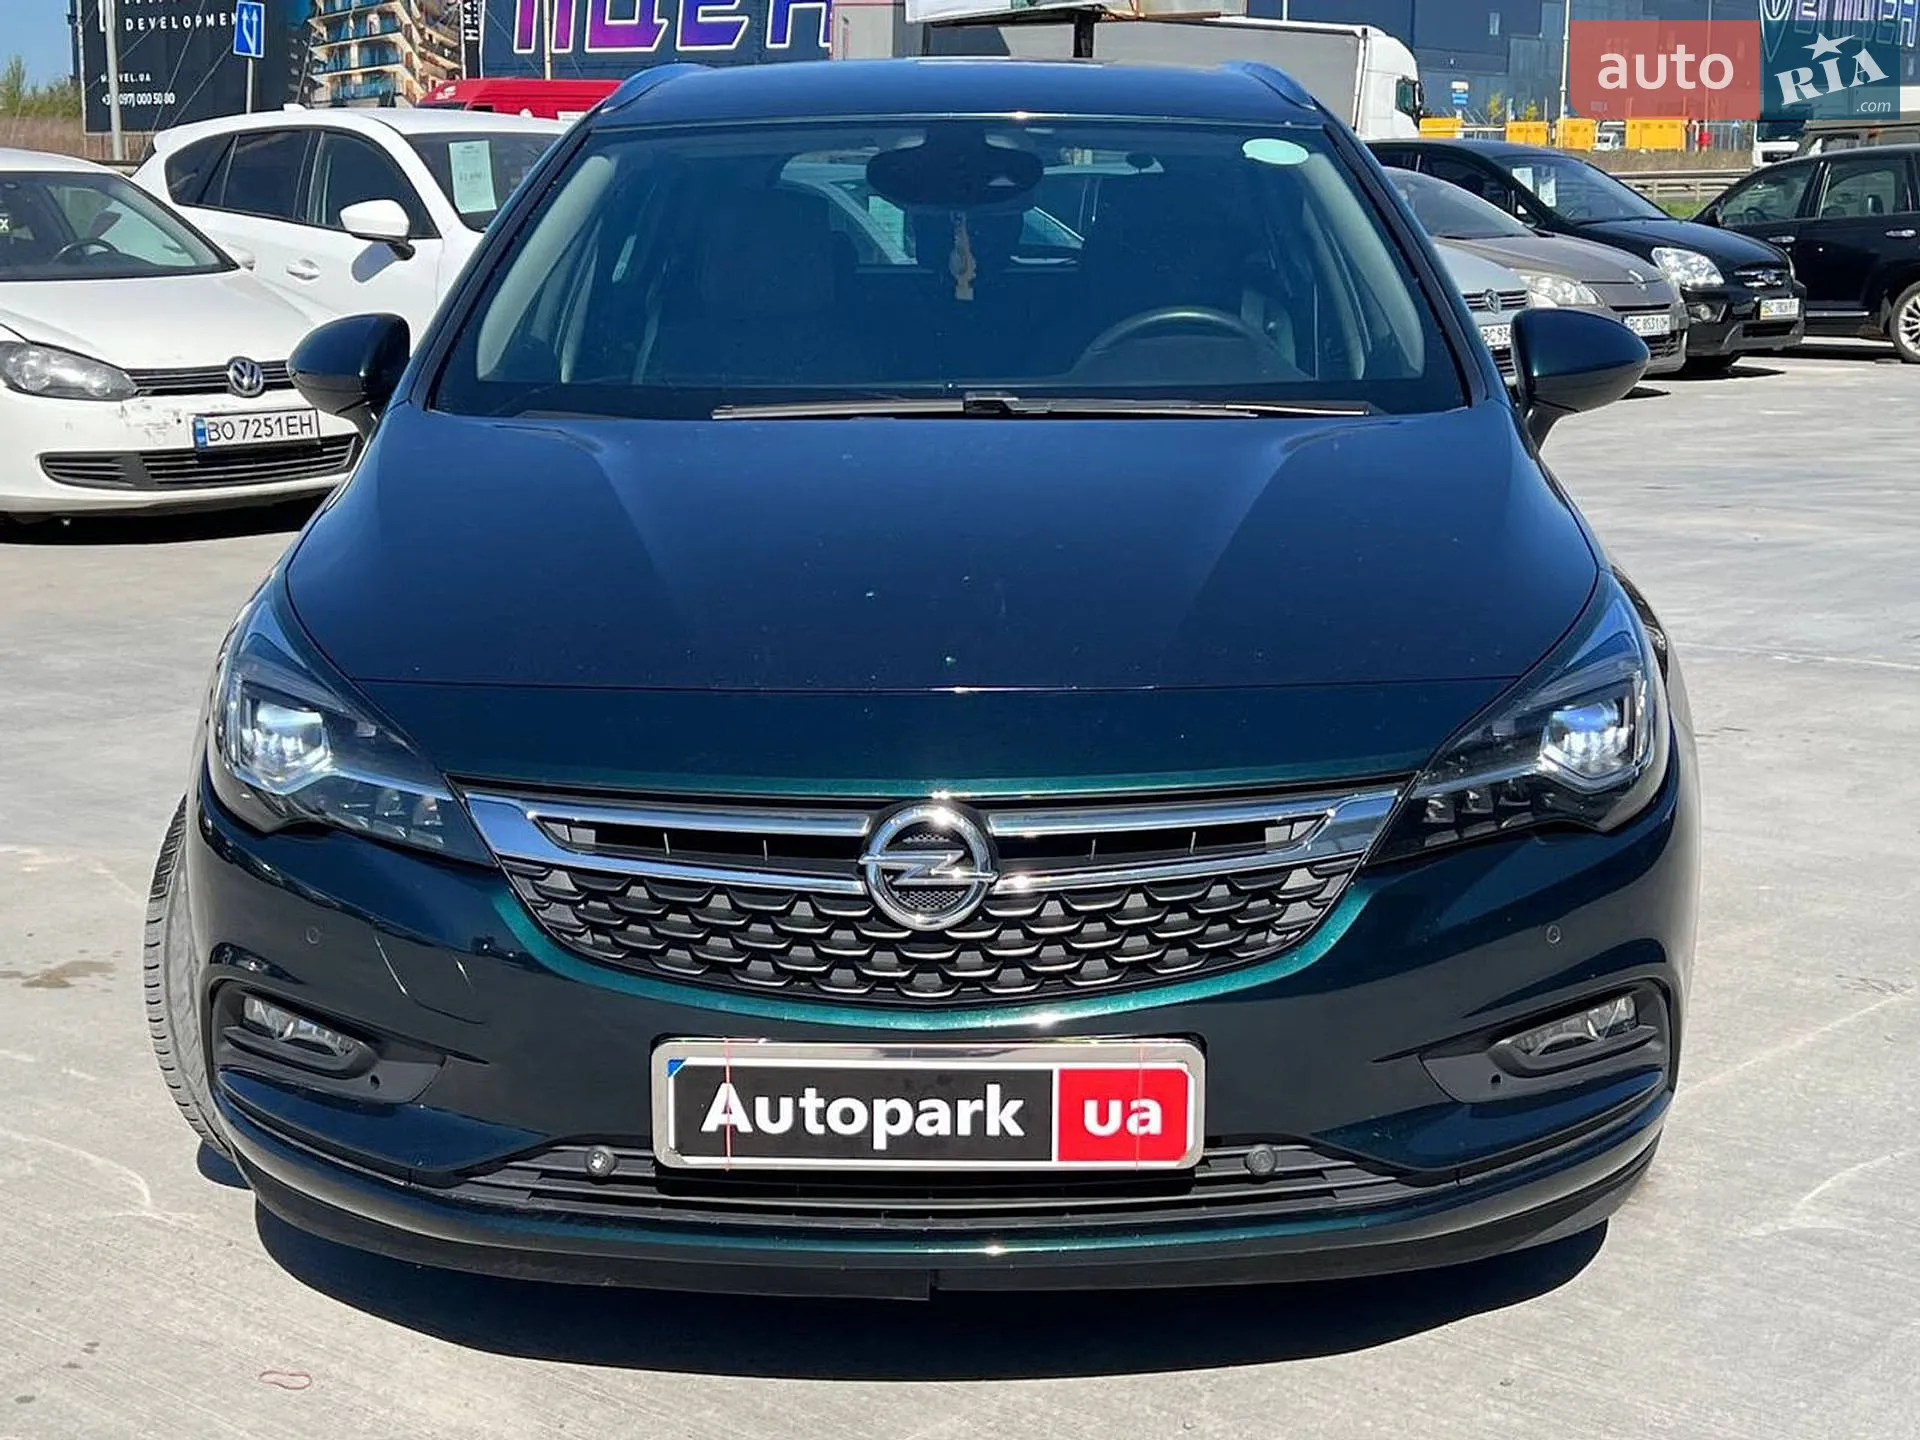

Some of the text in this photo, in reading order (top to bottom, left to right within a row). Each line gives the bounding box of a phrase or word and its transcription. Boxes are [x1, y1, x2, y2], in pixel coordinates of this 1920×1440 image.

[125, 12, 237, 32] DEVELOPMEN
[701, 1082, 1163, 1150] Autopark ua
